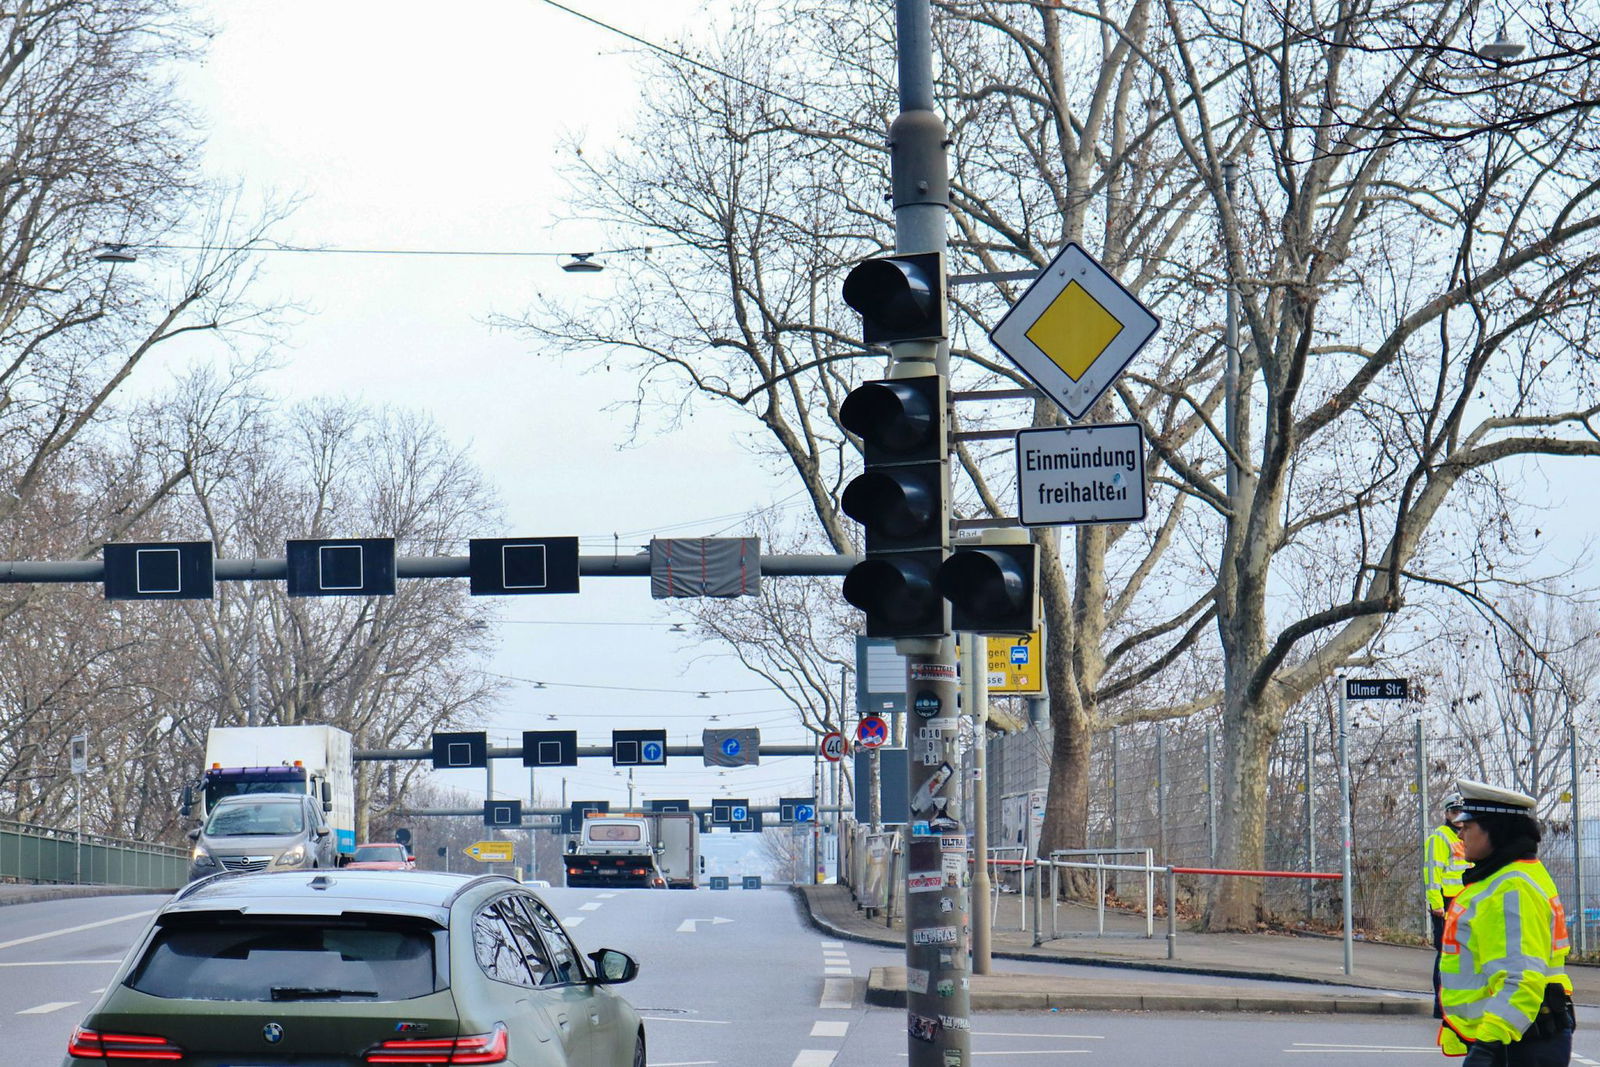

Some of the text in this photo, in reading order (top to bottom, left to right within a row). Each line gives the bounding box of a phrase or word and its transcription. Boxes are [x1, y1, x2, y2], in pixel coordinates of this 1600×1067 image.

[1025, 446, 1136, 472] Einmündung
[1038, 480, 1127, 505] freihalten
[1350, 683, 1404, 696] Ulmer Str.
[921, 729, 940, 739] 010
[928, 742, 934, 752] S
[925, 755, 938, 764] 81
